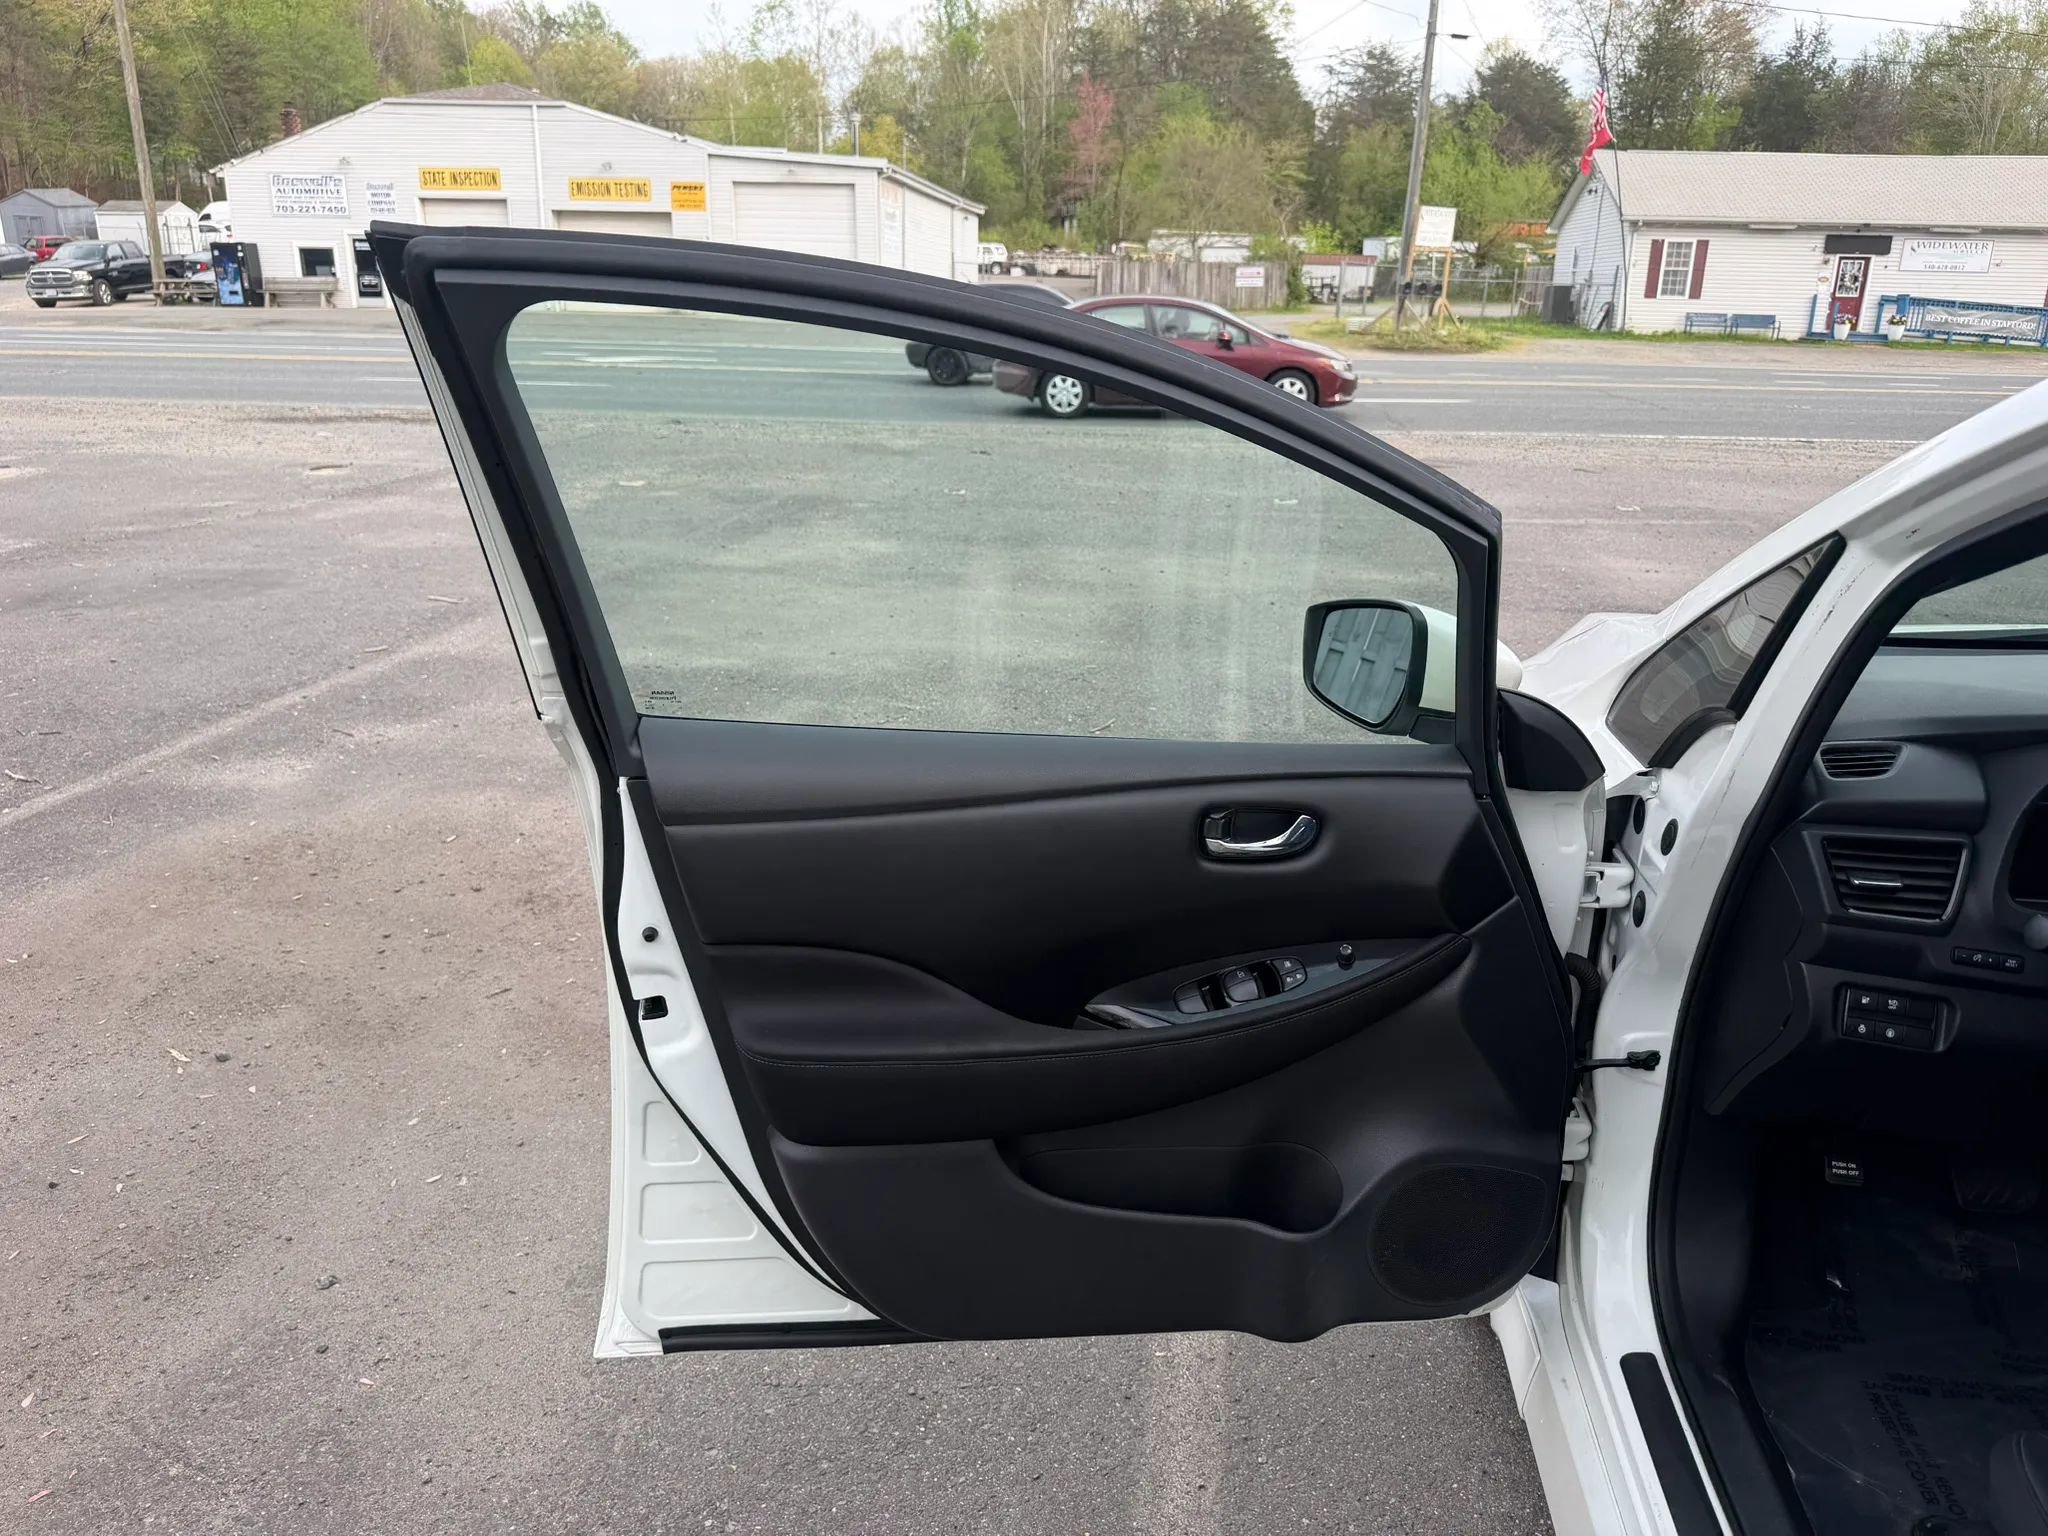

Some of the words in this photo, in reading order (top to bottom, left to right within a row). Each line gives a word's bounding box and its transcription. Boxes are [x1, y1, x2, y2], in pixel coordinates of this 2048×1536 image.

[422, 170, 446, 187] STATE
[450, 171, 498, 187] INSPECTION
[572, 181, 611, 197] EMISSION
[614, 182, 648, 198] TESTING
[1916, 240, 1989, 250] WIDEWATER
[1925, 314, 1949, 323] BEST
[1948, 317, 1980, 326] COFFEE
[1980, 319, 1992, 327] IN
[1991, 319, 2037, 330] STAFFORD!
[1831, 1160, 1847, 1168] PUSH
